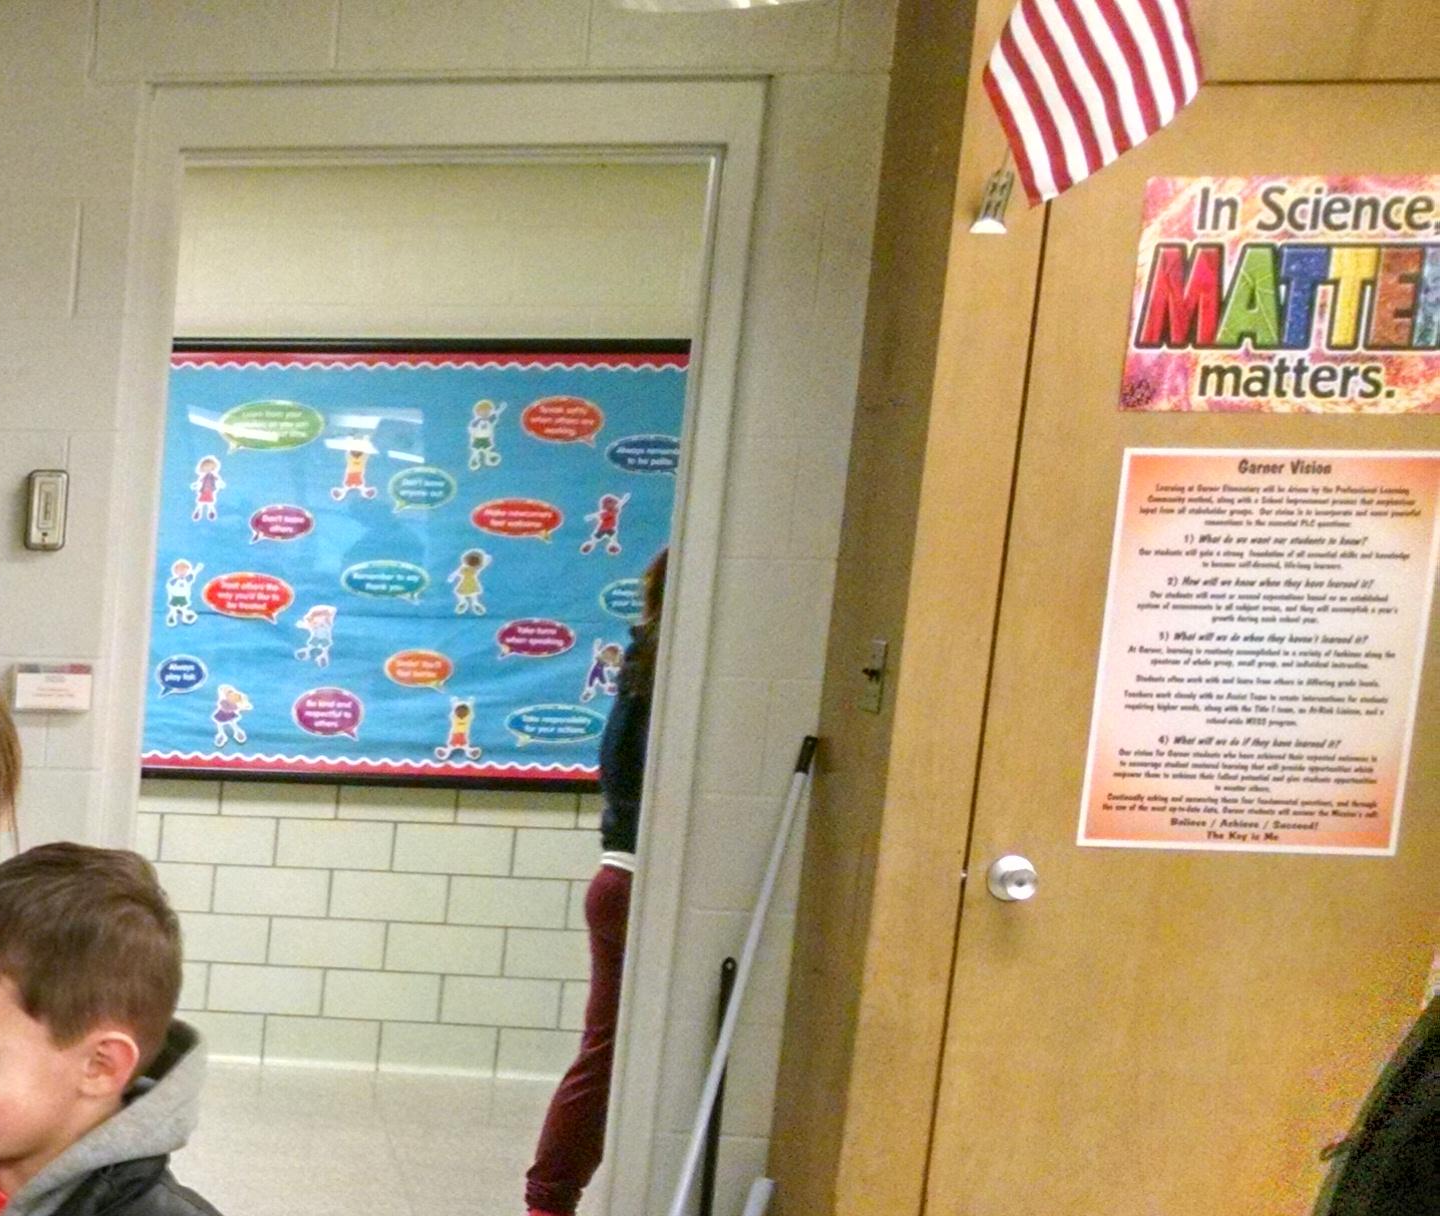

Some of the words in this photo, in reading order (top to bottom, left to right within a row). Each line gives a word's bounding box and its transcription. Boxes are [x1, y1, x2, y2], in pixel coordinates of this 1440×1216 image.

[1196, 186, 1239, 232] In
[1198, 358, 1396, 399] matters.
[1290, 459, 1333, 475] Vision
[1198, 533, 1222, 545] What
[1223, 534, 1234, 545] do
[1250, 535, 1271, 545] want
[1290, 535, 1326, 546] students
[1182, 575, 1201, 587] How
[1202, 576, 1219, 587] will
[1234, 577, 1256, 588] know
[1283, 577, 1302, 590] they
[1173, 630, 1197, 642] What
[1198, 631, 1215, 642] will
[1230, 632, 1241, 642] do
[1242, 632, 1265, 643] when
[1267, 633, 1286, 645] they
[1172, 735, 1197, 746] What
[1197, 736, 1215, 746] will
[1229, 736, 1240, 747] do
[1251, 737, 1270, 749] they
[1170, 816, 1208, 828] Believe
[1219, 818, 1260, 830] Achieve
[1206, 830, 1225, 841] The
[1228, 831, 1248, 843] Key
[1263, 832, 1280, 842] Me
